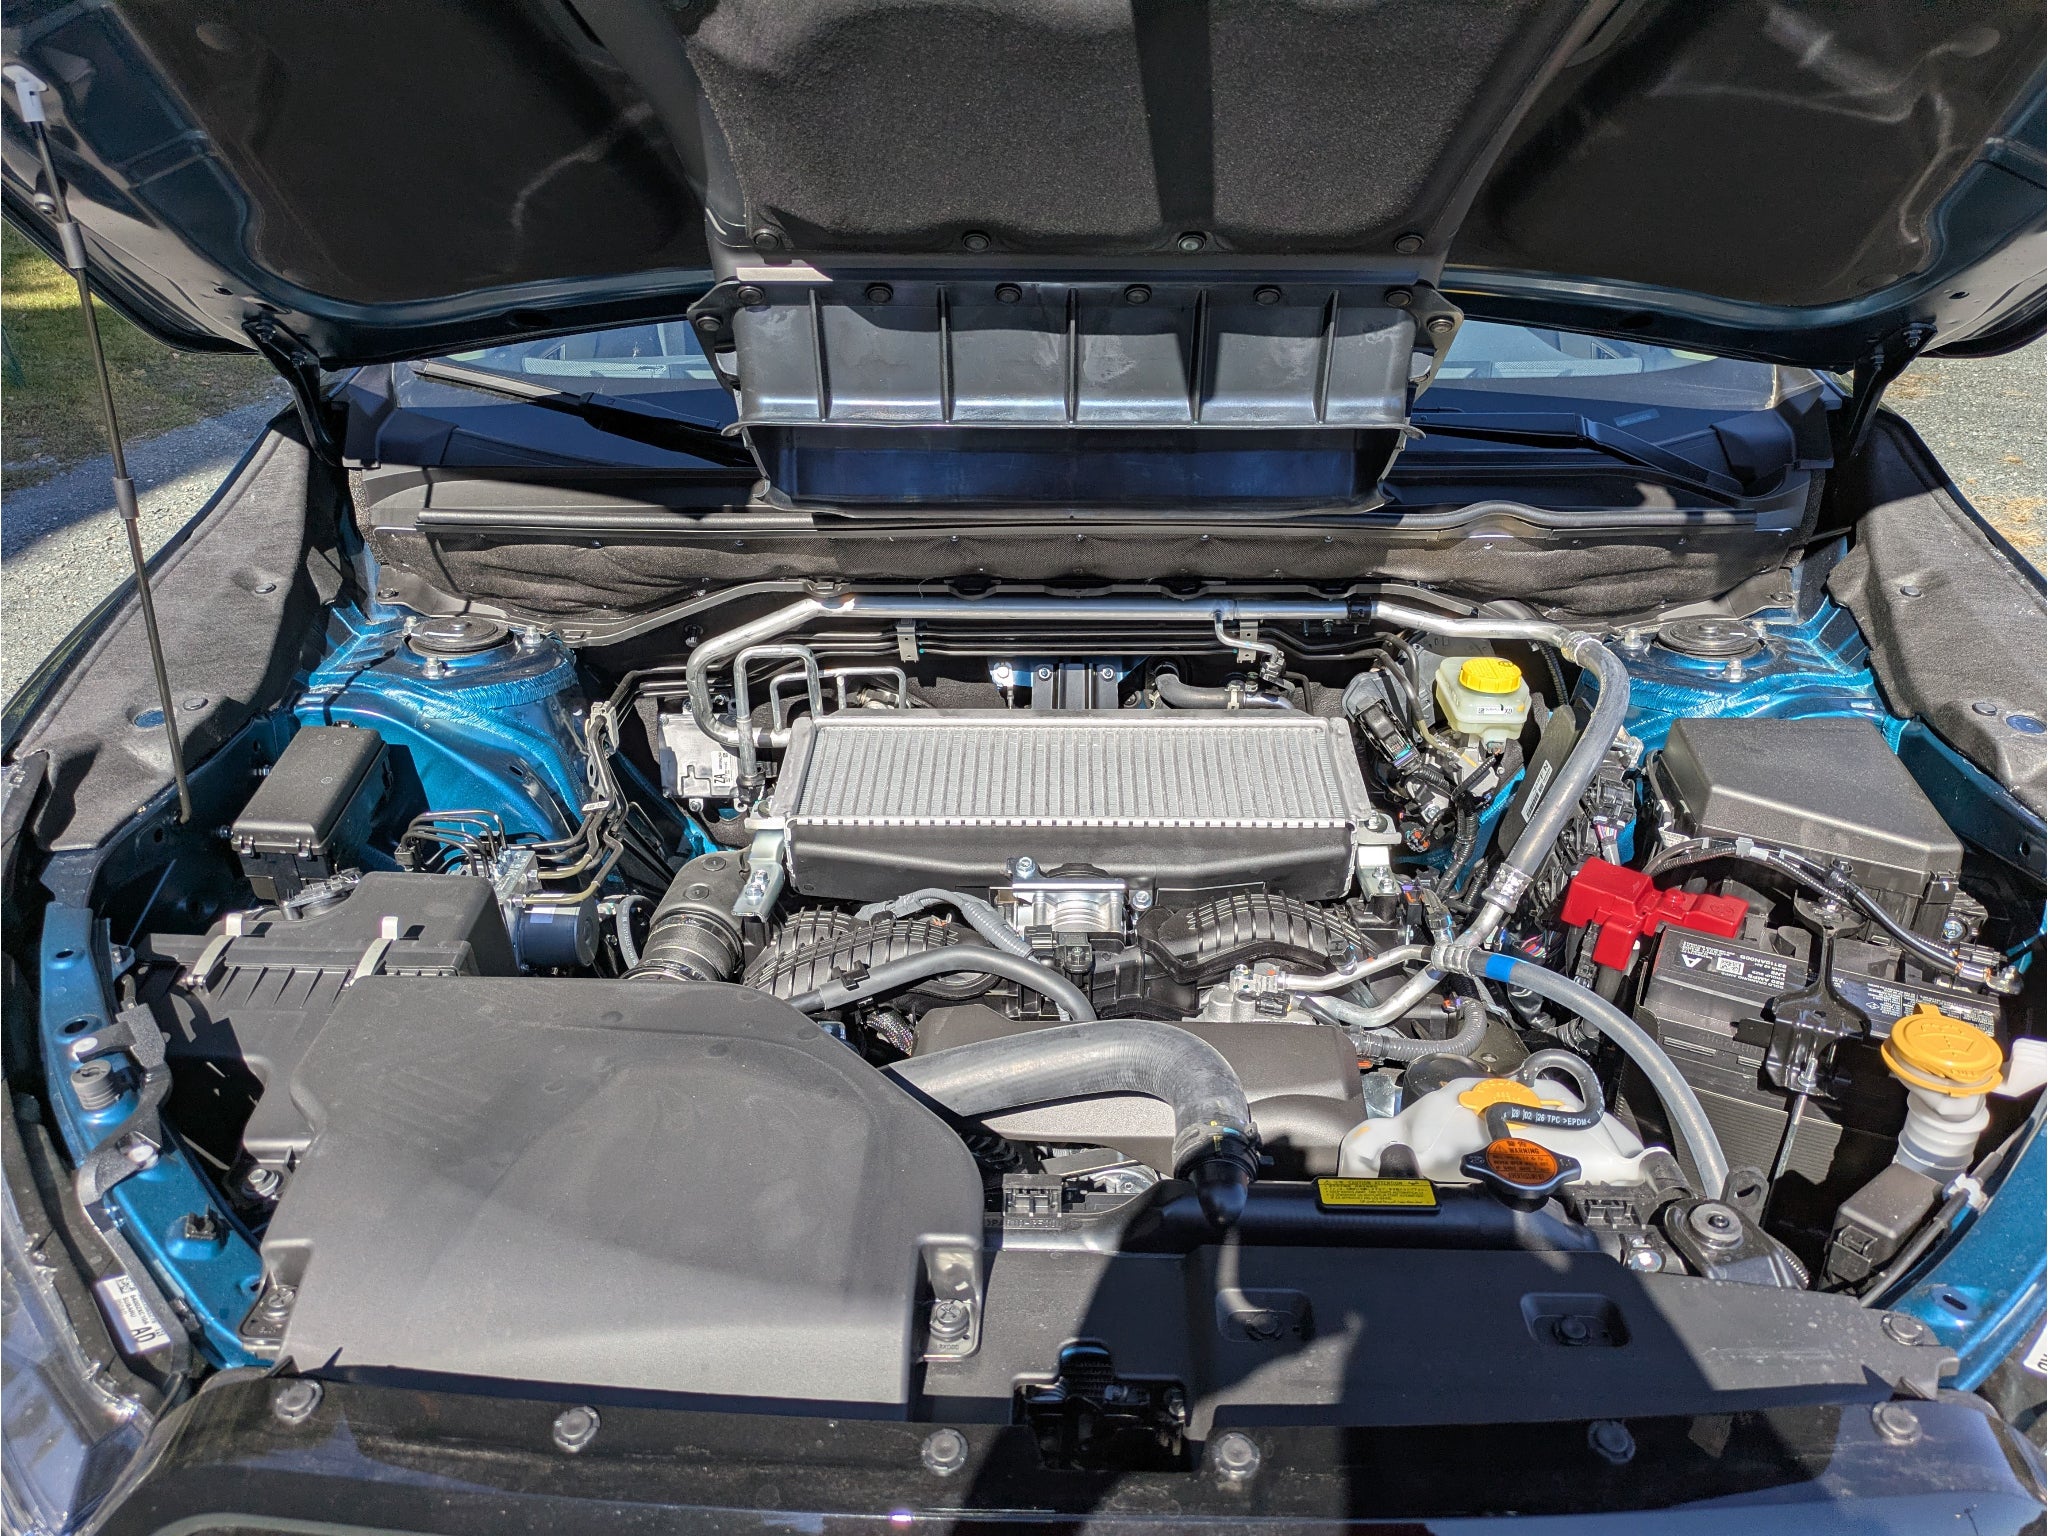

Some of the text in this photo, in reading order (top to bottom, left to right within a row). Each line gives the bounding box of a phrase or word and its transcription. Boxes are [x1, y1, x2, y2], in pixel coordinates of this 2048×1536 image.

[1720, 971, 1738, 979] AMPS
[1747, 973, 1770, 982] AMPS
[1737, 976, 1768, 986] CRANKING
[1547, 1114, 1561, 1124] TPC
[1509, 1147, 1540, 1155] WARNING
